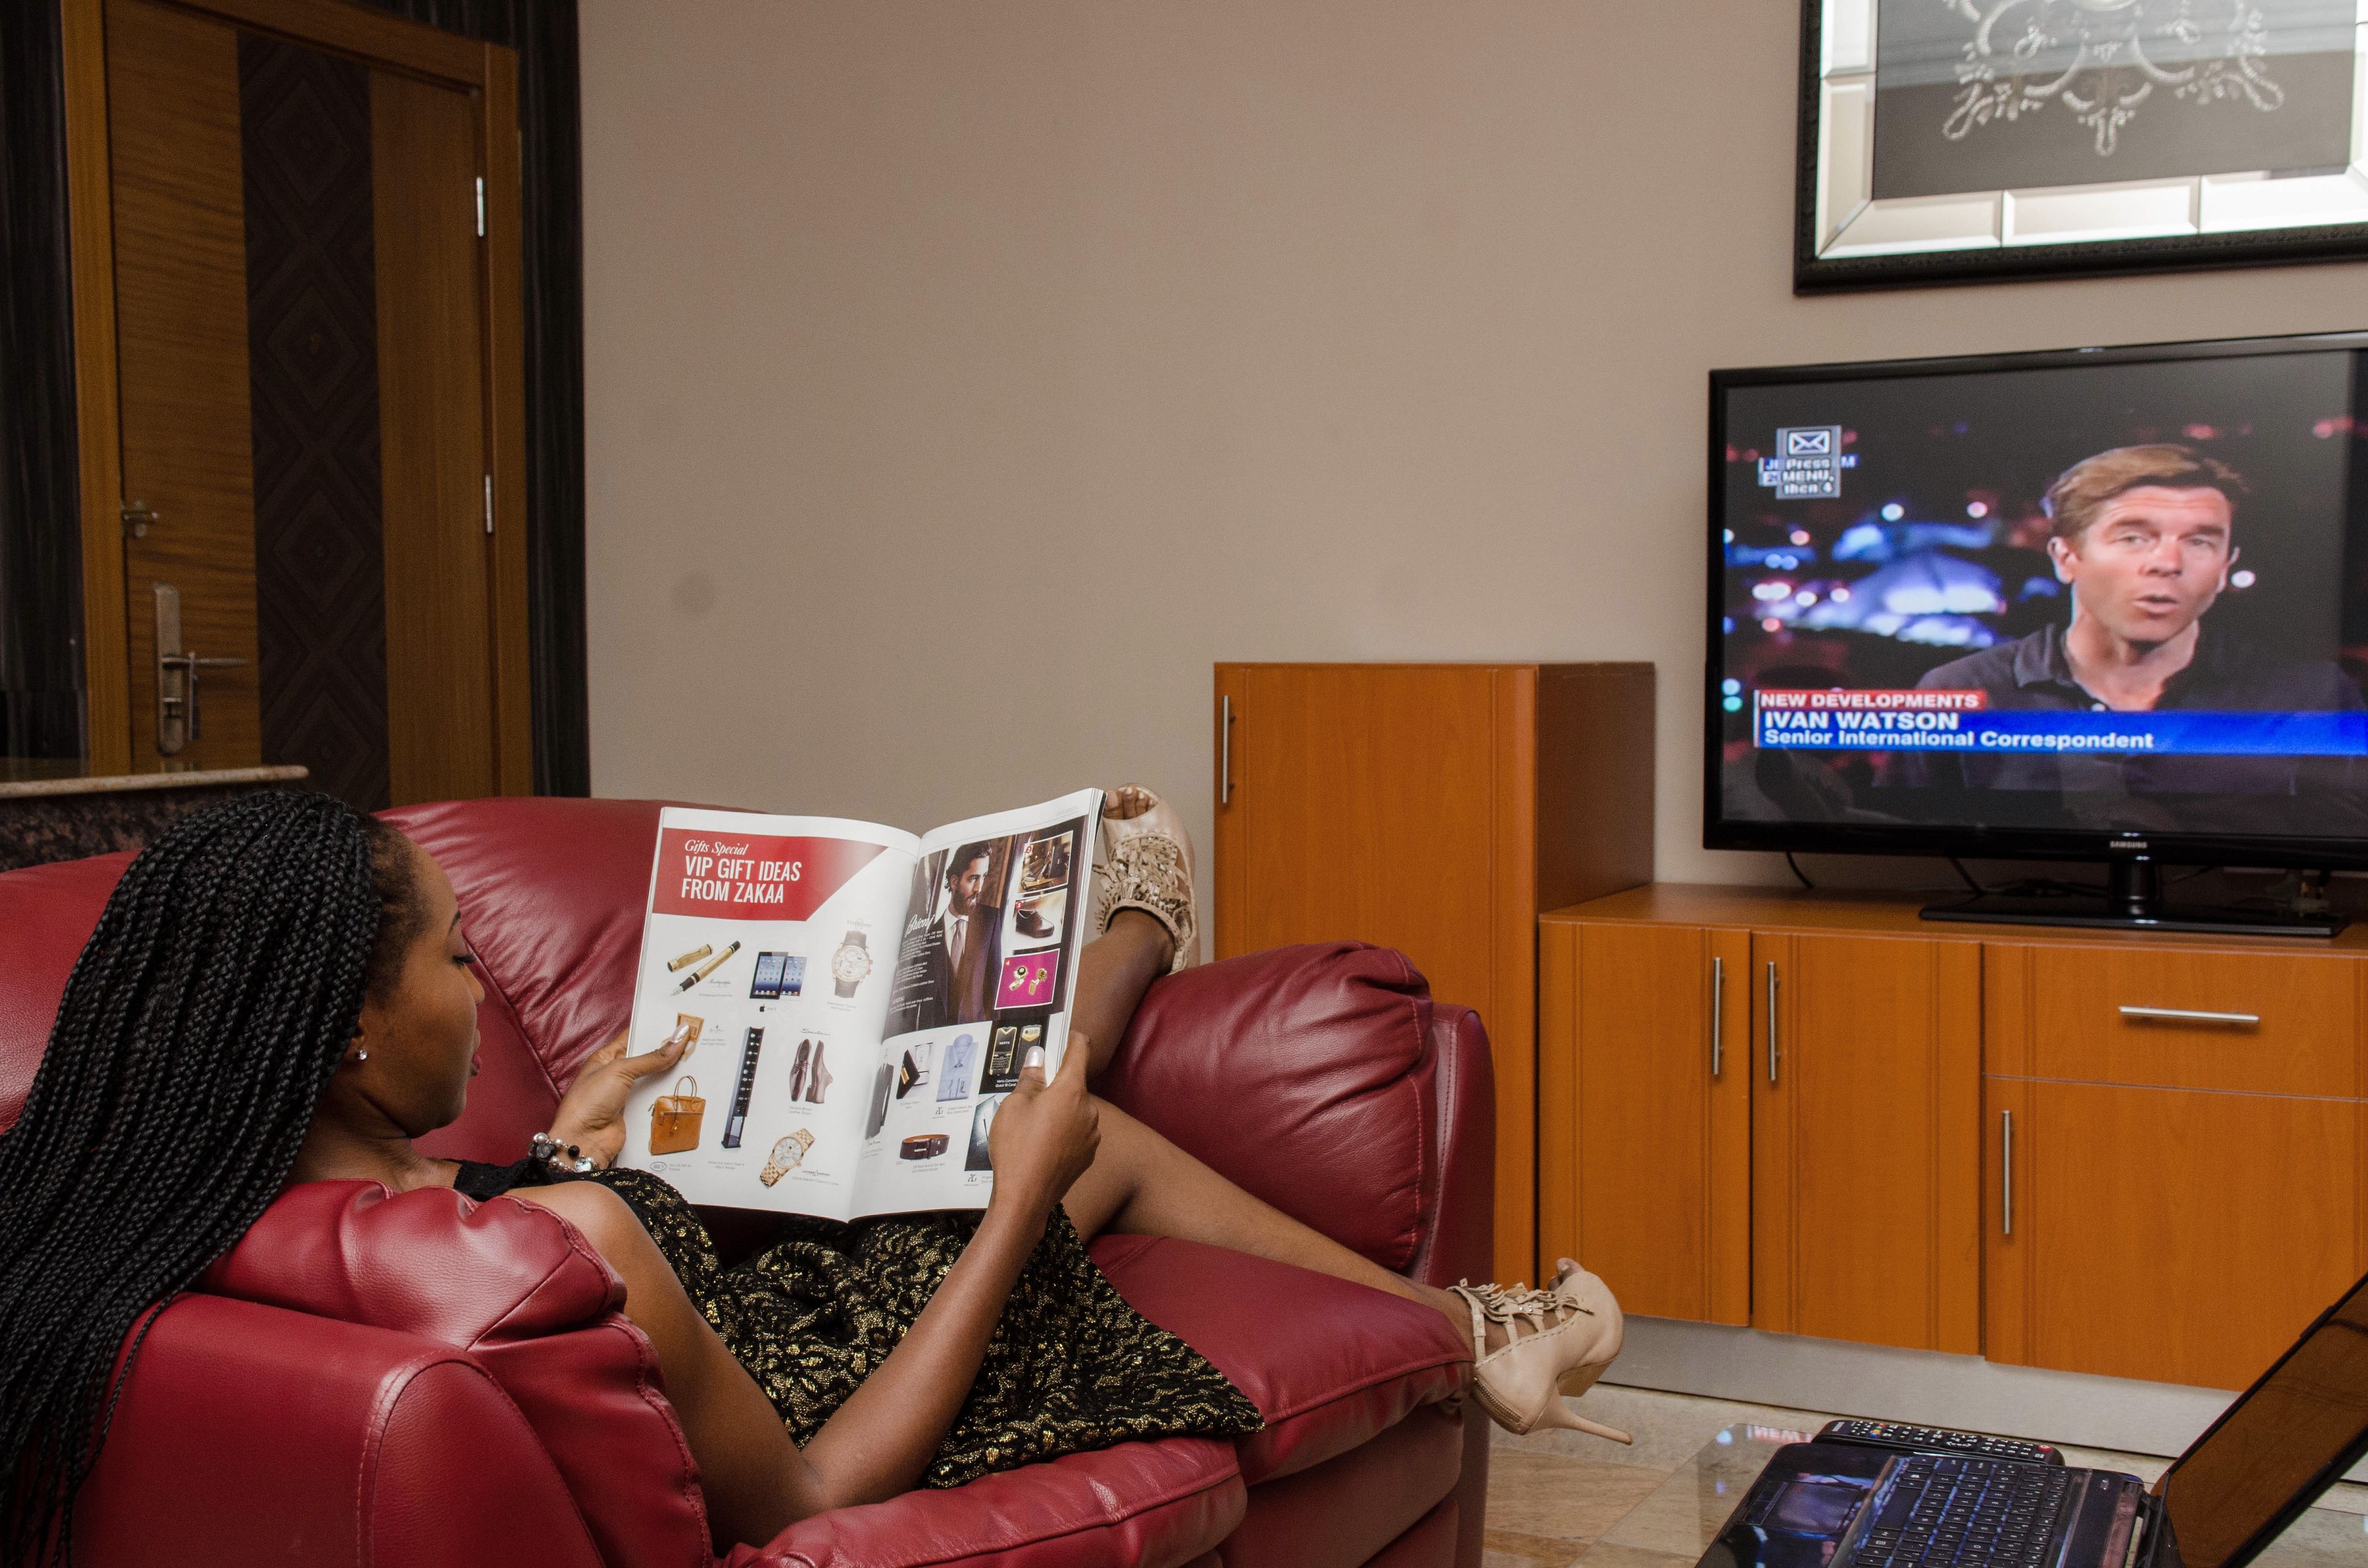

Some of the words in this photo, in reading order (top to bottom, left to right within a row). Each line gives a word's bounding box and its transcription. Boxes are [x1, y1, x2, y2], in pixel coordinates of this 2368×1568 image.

[1785, 458, 1830, 470] Press
[1760, 693, 1807, 708] NEW
[1811, 693, 1980, 708] DEVELOPMENTS
[1764, 711, 1829, 729] IVAN
[1835, 711, 1959, 731] WATSON
[1765, 729, 1833, 745] Senior
[1839, 729, 1974, 746] International
[1980, 730, 2154, 751] Correspondent
[684, 839, 710, 854] Gifts
[711, 841, 749, 856] Special
[2110, 840, 2148, 849] SAMSUNG
[685, 855, 713, 877] VIP
[717, 858, 755, 880] GIFT
[758, 861, 802, 882] IDEAS
[681, 877, 730, 901] FROM
[733, 882, 784, 904] ZAKAA
